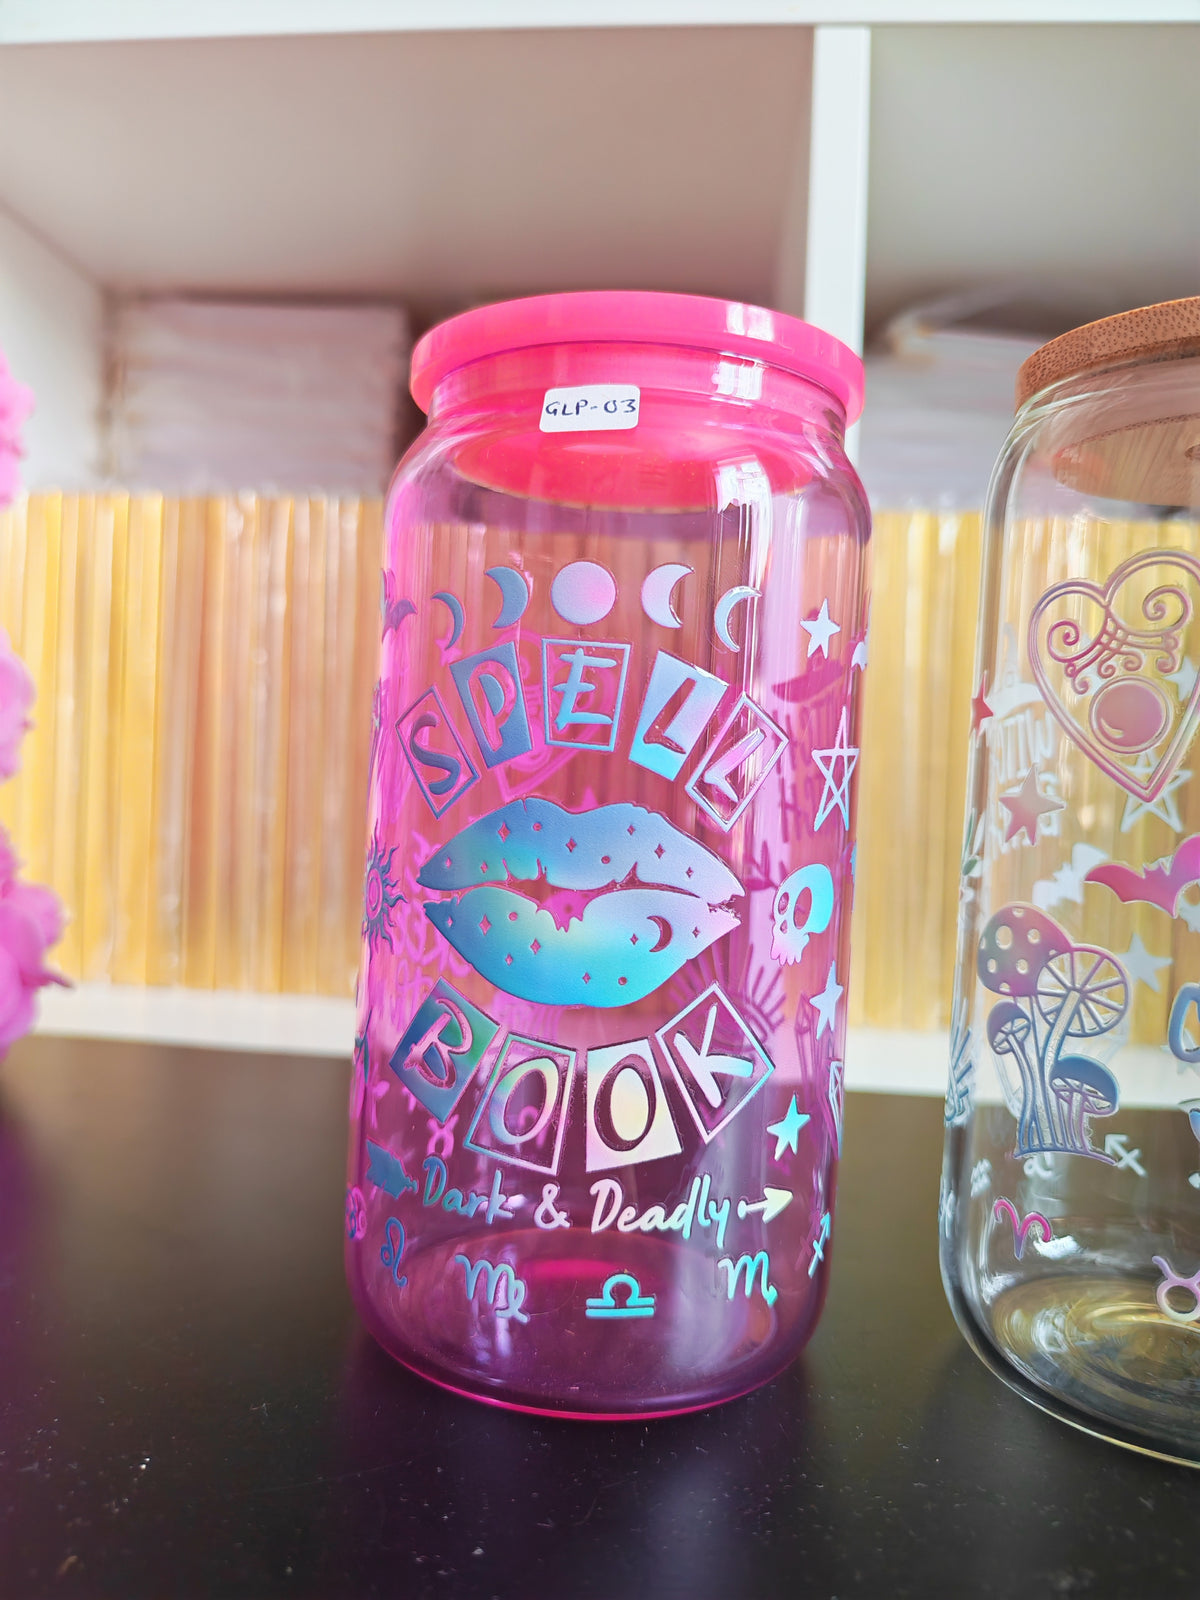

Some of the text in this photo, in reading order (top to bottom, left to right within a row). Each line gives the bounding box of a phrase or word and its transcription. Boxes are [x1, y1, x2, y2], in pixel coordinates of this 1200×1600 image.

[545, 398, 637, 416] GLP-03
[407, 646, 768, 804] SPELL
[402, 998, 755, 1152] BOOK
[423, 1156, 730, 1248] Dark & Deadly
